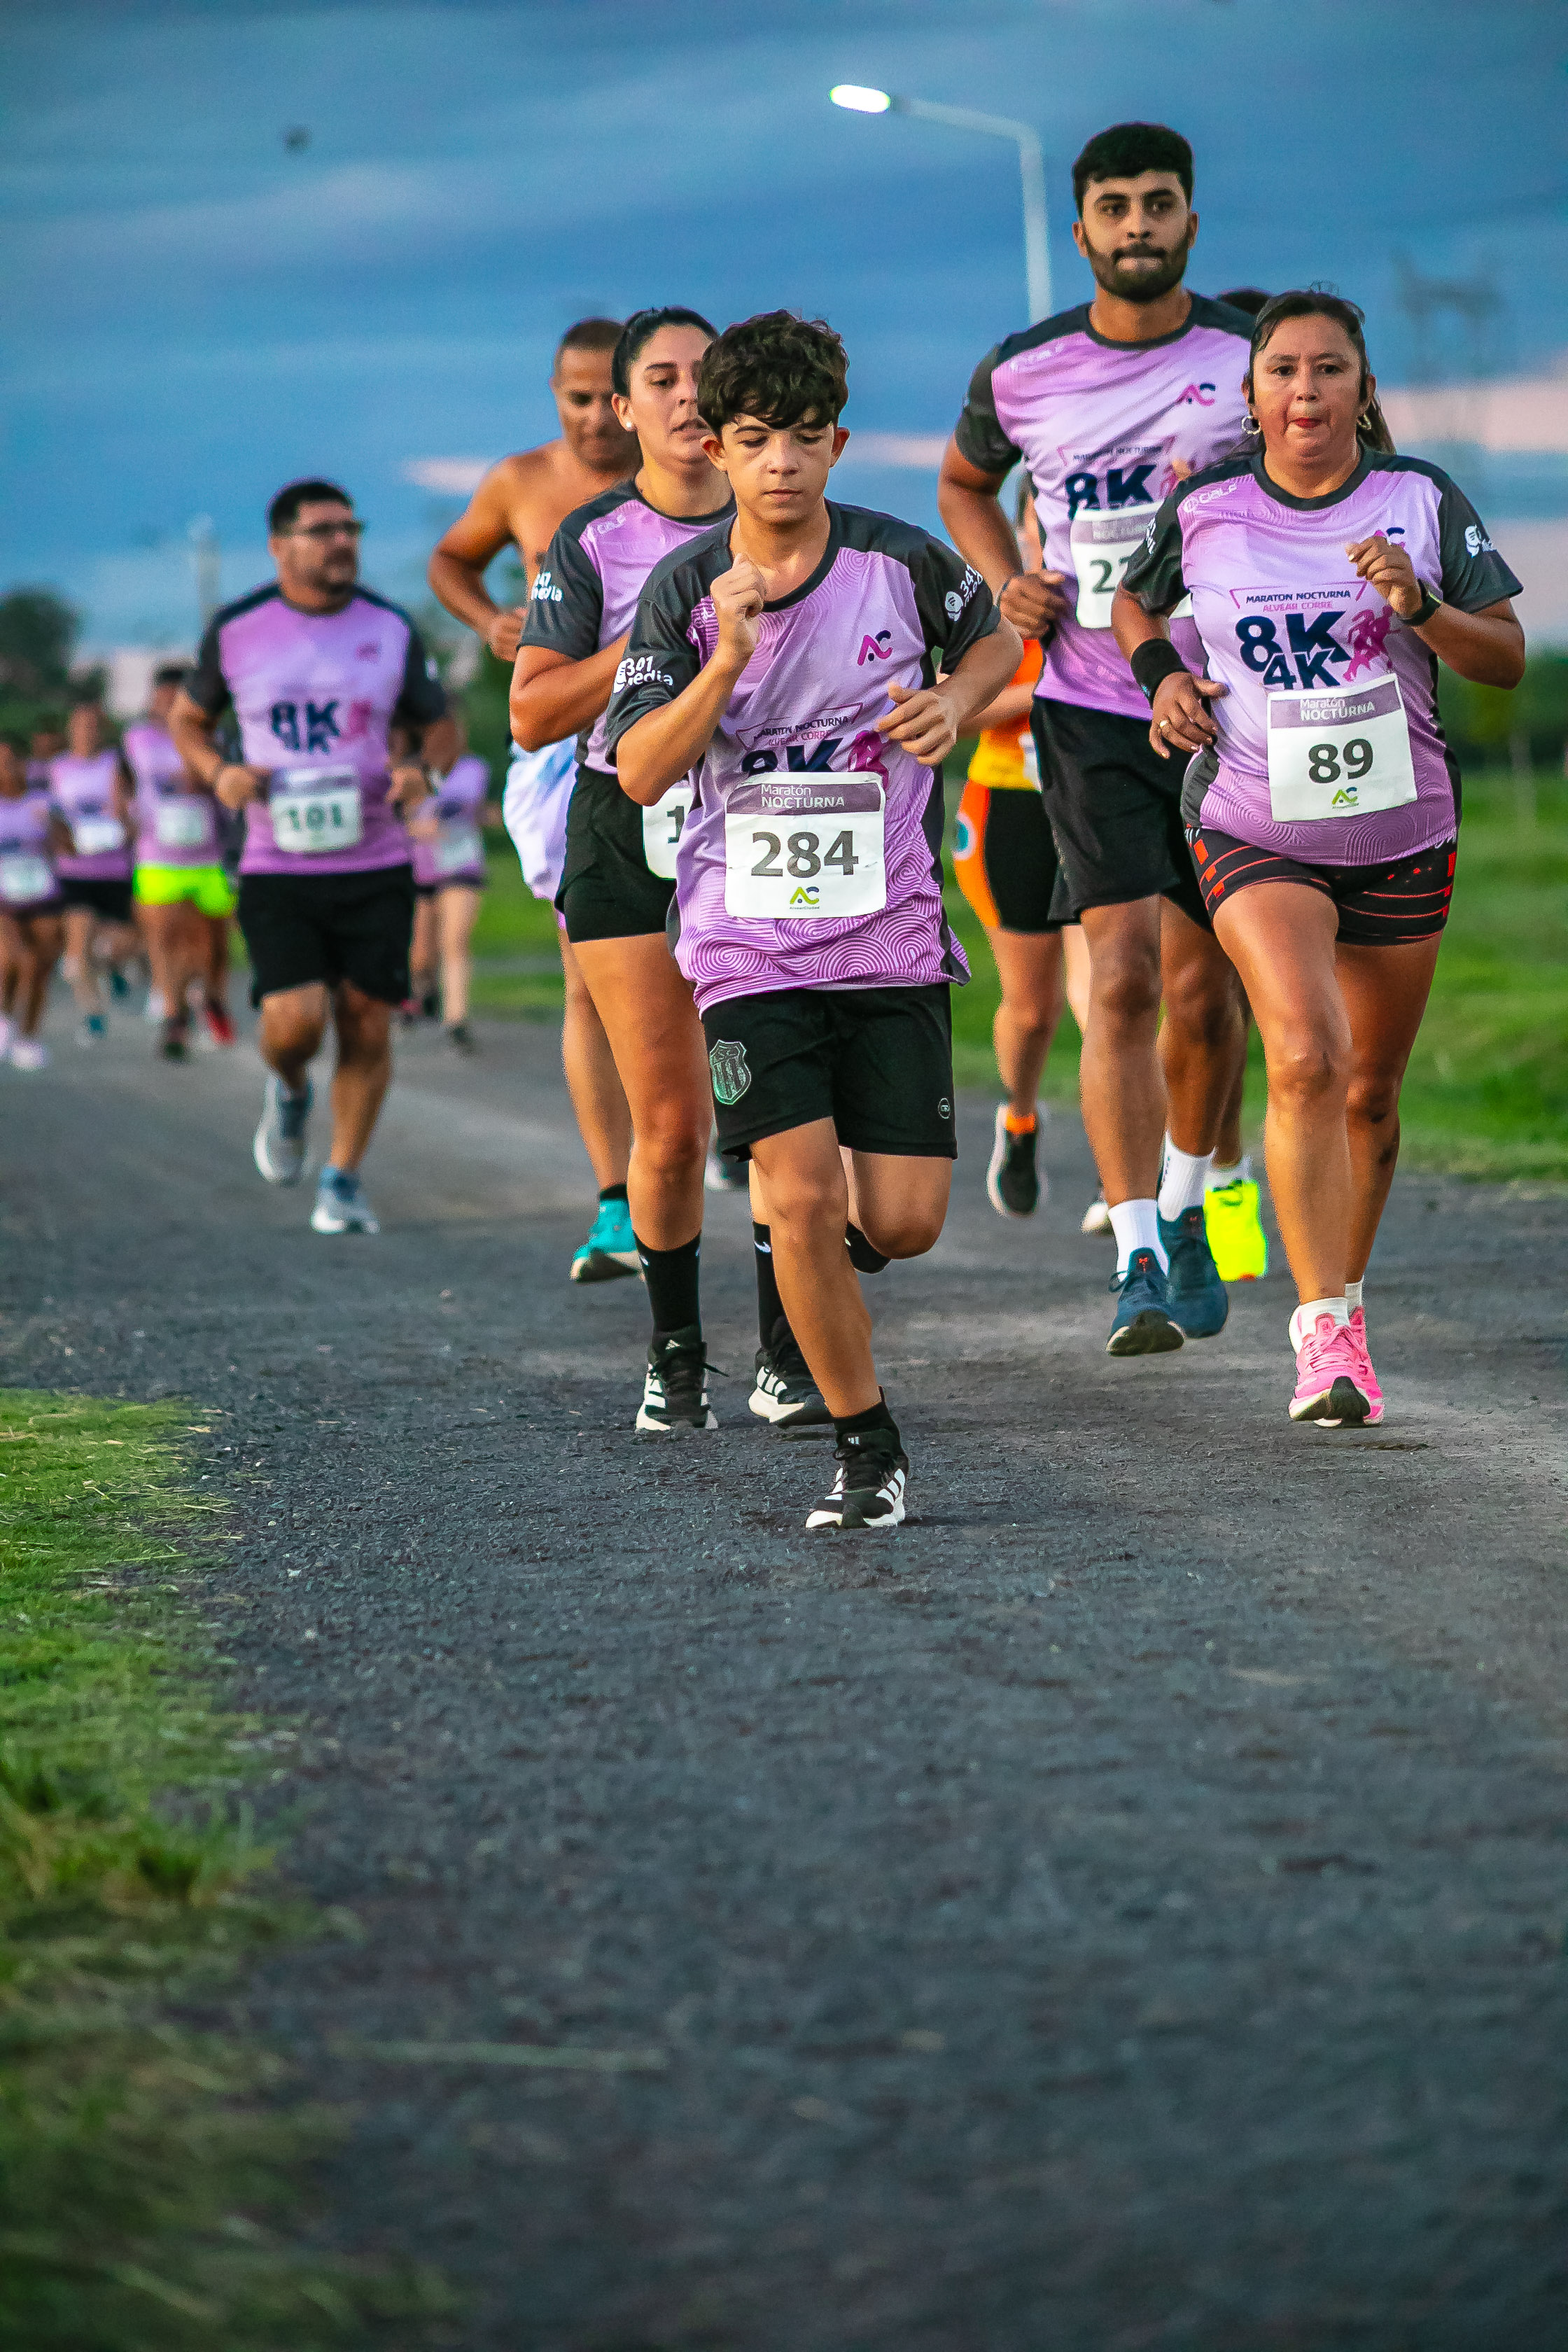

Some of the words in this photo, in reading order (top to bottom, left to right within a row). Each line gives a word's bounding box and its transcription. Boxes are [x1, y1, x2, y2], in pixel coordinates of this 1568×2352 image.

[1246, 594, 1293, 603] MARATON
[1296, 589, 1351, 601] NOCTURNA
[1235, 610, 1353, 673] 8K
[1263, 649, 1340, 690] 4K
[1301, 701, 1376, 721] NOCTURNA
[1308, 738, 1373, 783] 89
[761, 784, 812, 795] Maratón
[761, 797, 845, 809] NOCTURNA
[751, 830, 860, 878] 284
